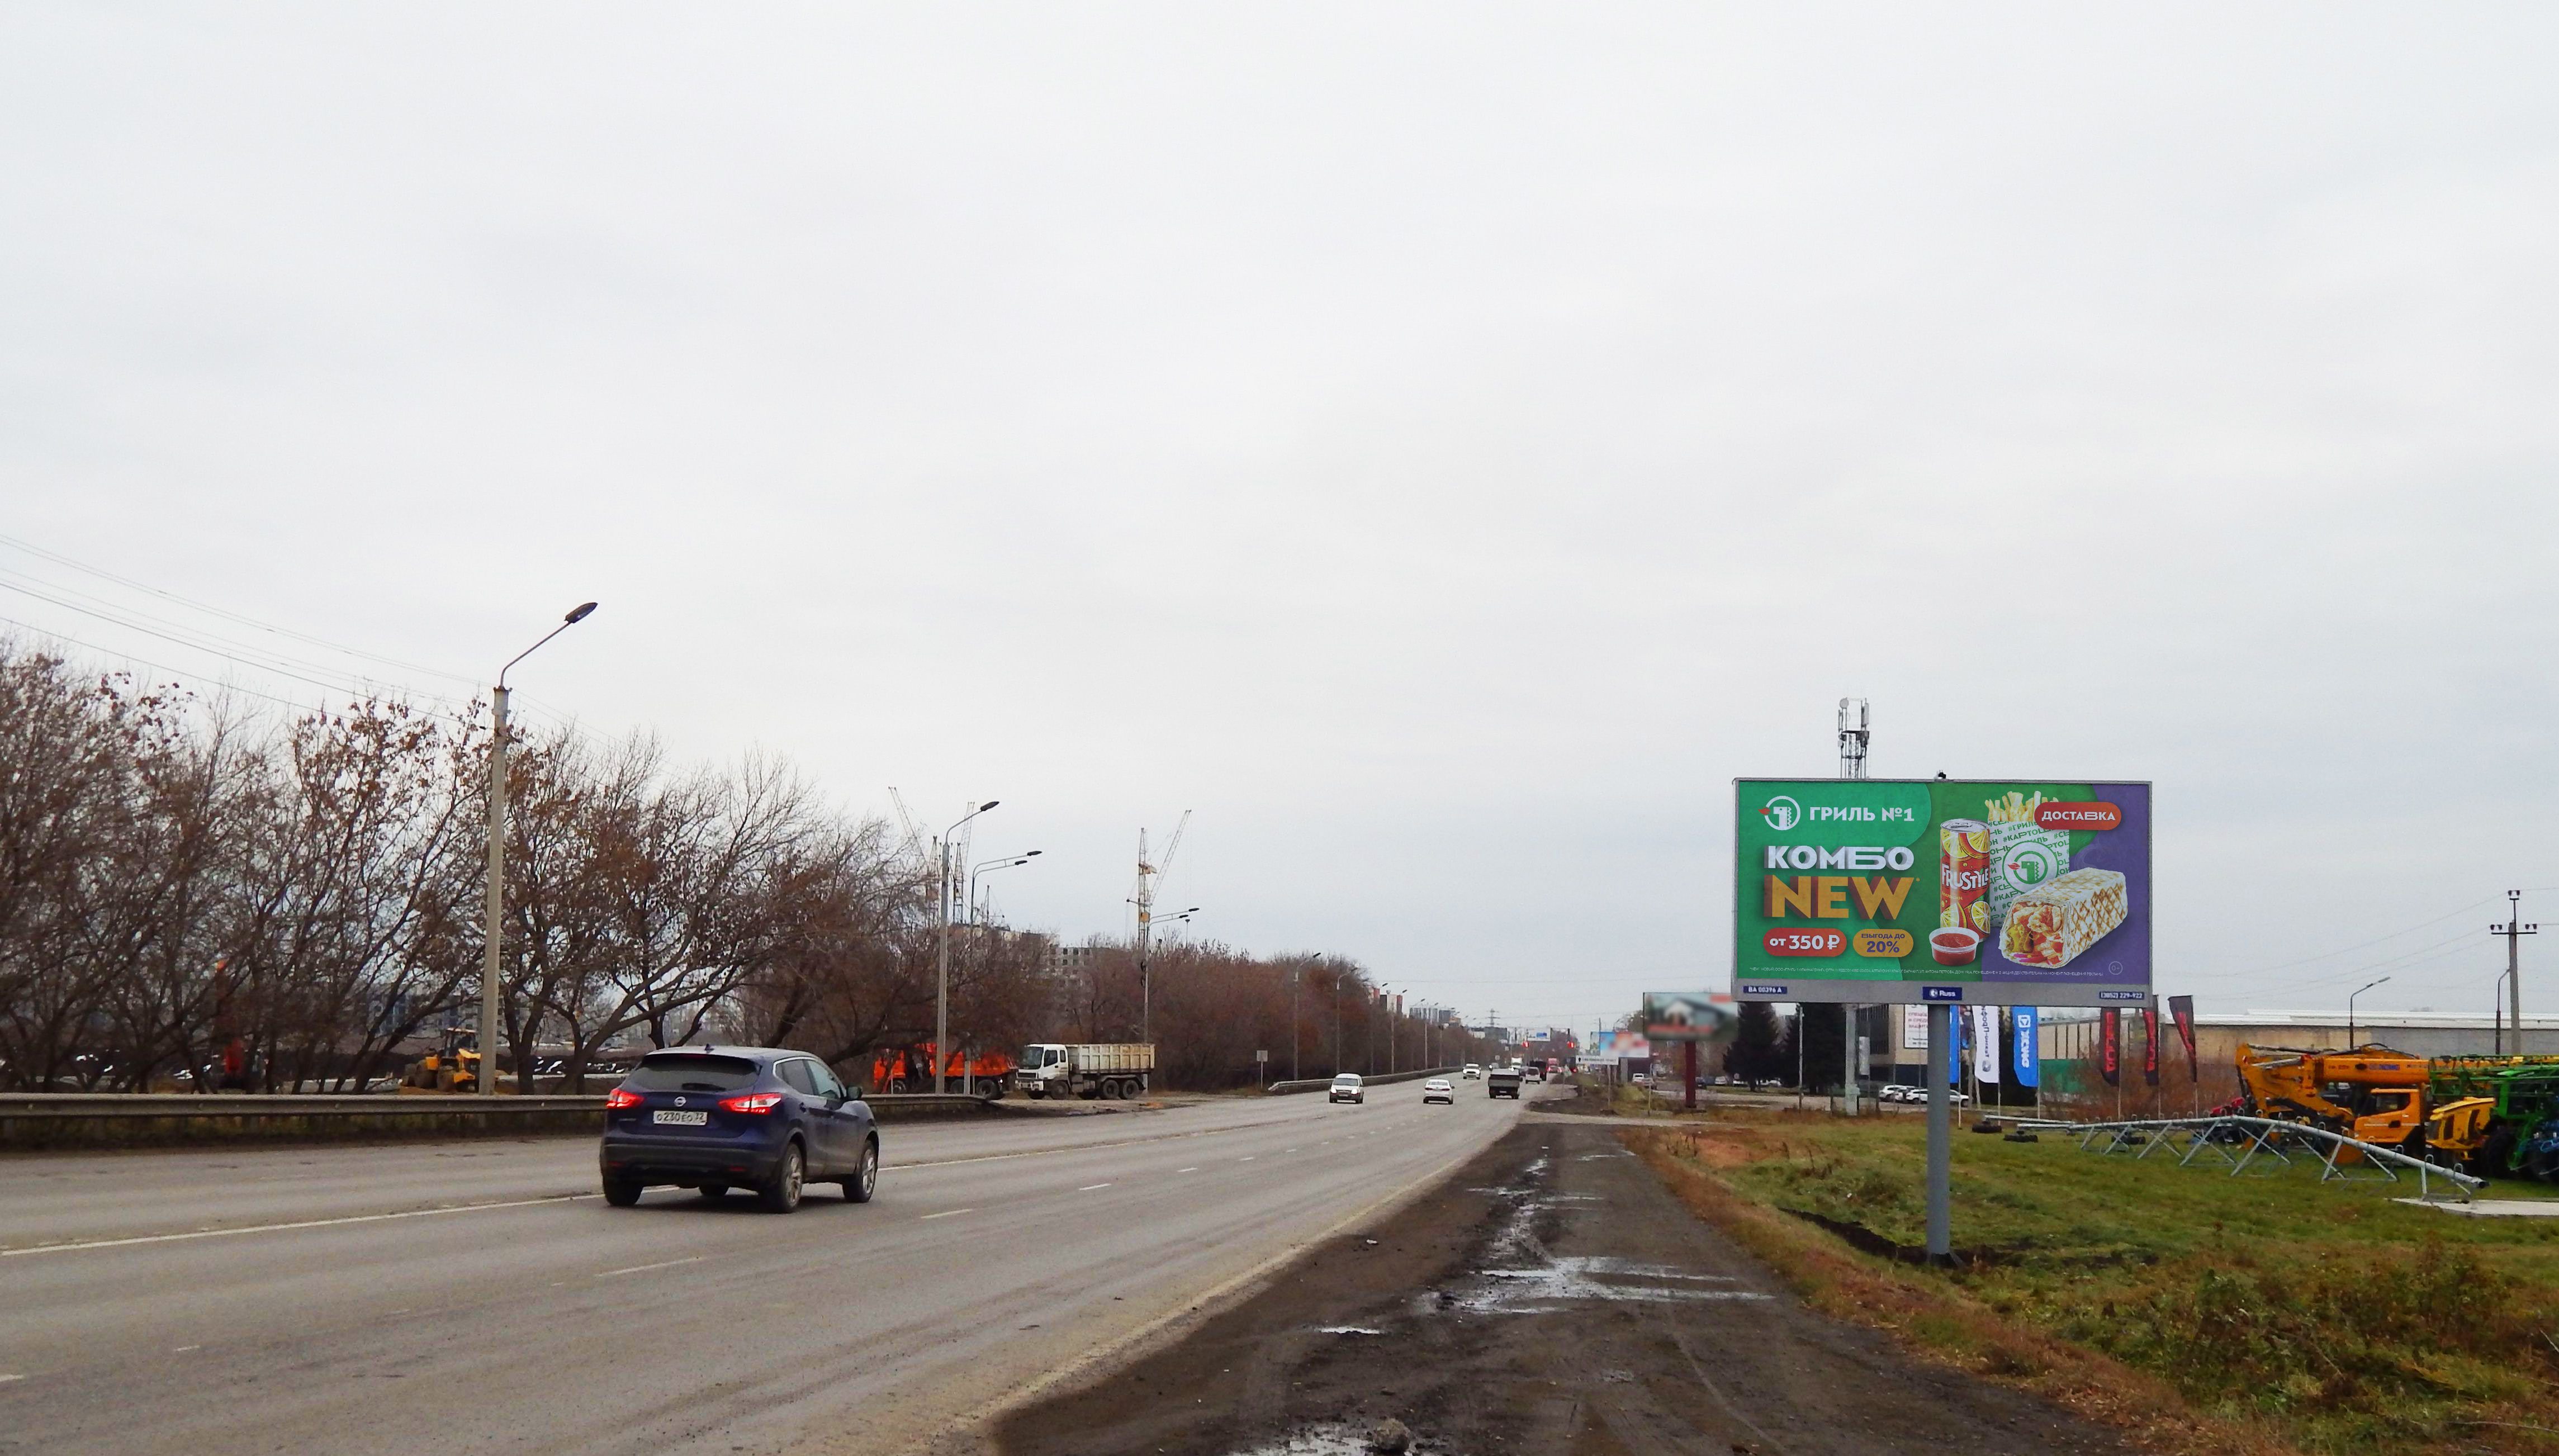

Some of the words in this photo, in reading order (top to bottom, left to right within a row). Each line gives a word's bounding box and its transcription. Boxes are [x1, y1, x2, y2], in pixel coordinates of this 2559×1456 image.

[1809, 807, 1876, 821] ГРИЛЬ
[1882, 807, 1914, 822] №1
[2041, 811, 2116, 822] ДОСТАВКА
[1764, 845, 1914, 871] КОМБО
[1769, 938, 1786, 946] от
[1789, 935, 1824, 950] 350
[1866, 941, 1900, 953] 20%
